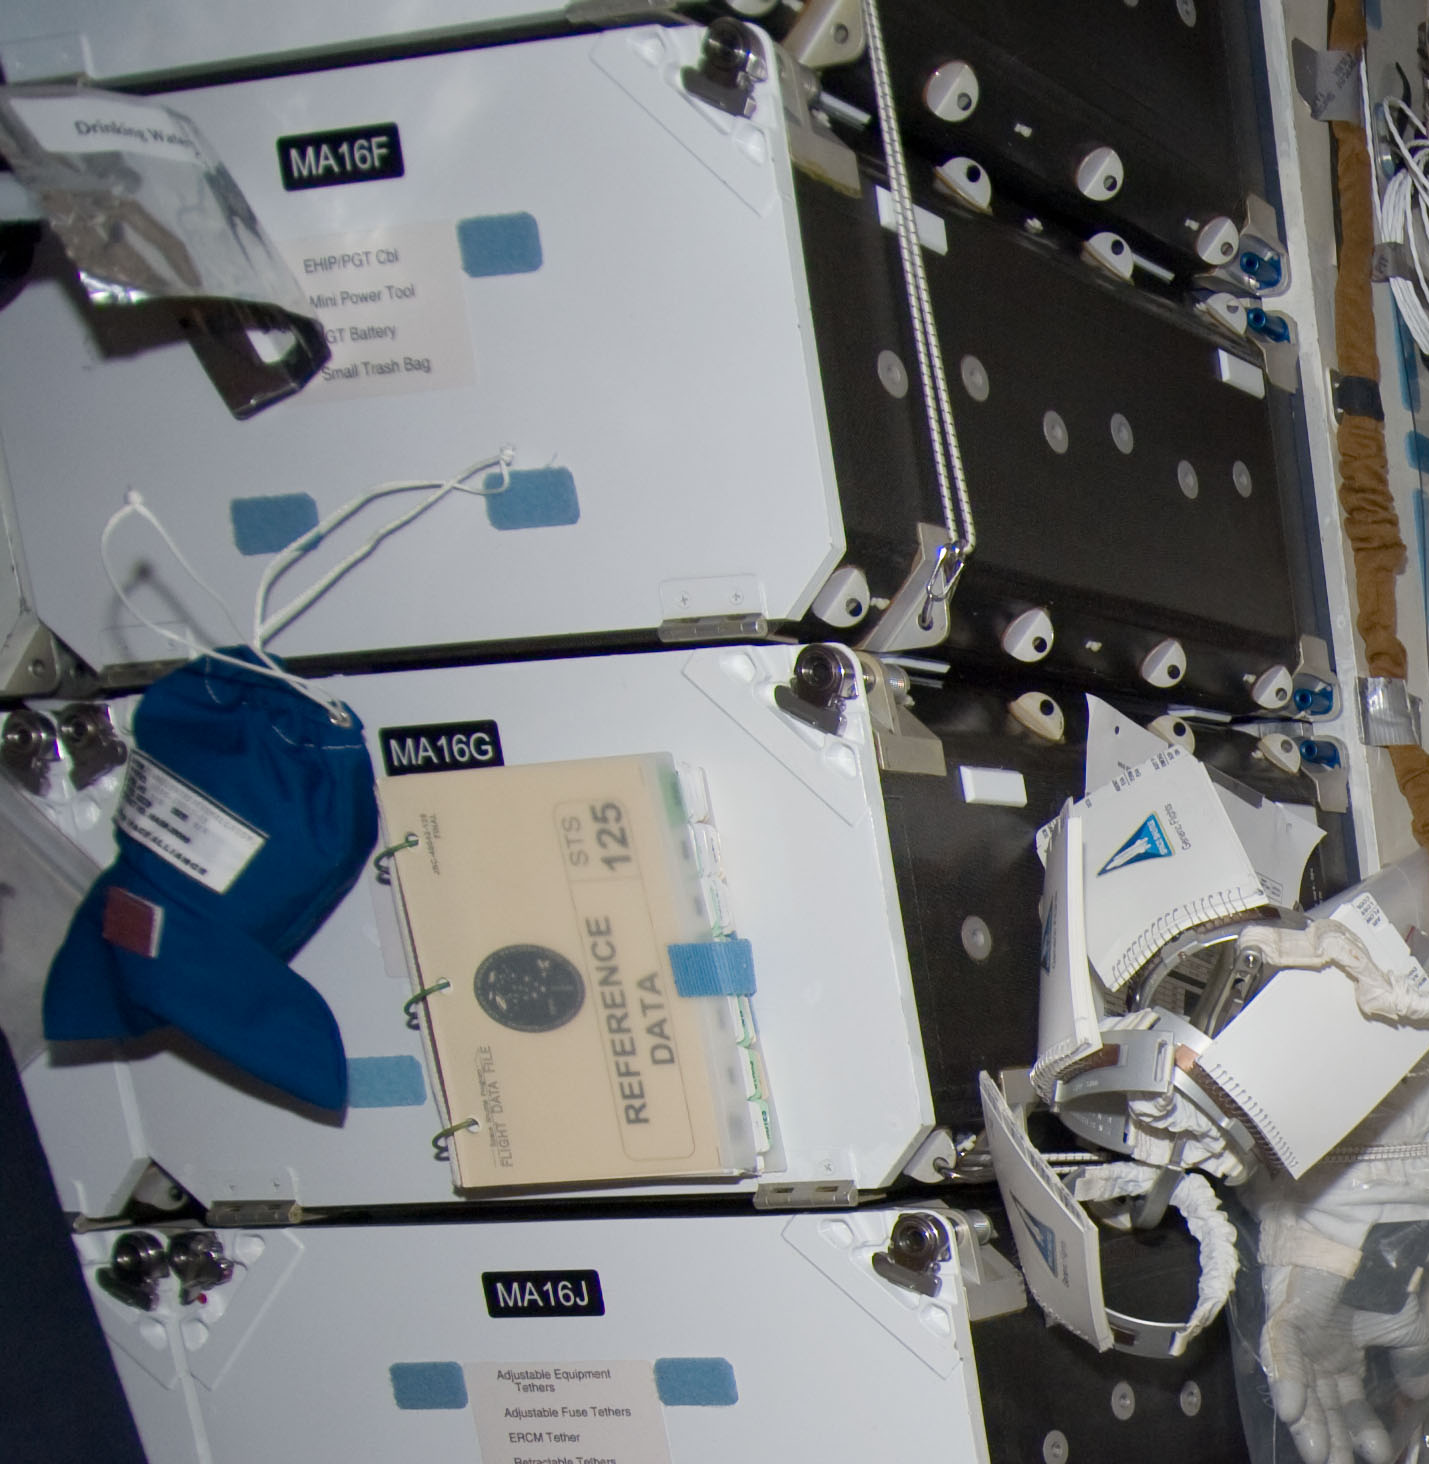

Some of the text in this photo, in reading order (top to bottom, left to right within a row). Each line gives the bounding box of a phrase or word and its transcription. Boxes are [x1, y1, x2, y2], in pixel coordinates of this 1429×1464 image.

[74, 119, 146, 142] Drinking
[289, 135, 390, 179] MA16F
[303, 251, 371, 274] EHIP/PGT
[310, 283, 416, 310] Mini Power Tool
[349, 324, 397, 343] Battery
[321, 356, 431, 381] Small Trash Bag
[389, 731, 494, 767] MA16G
[560, 815, 590, 868] STS
[589, 800, 633, 873] 125
[584, 914, 650, 1127] REFERENCE
[637, 971, 676, 1067] DATA
[481, 1046, 493, 1074] FILE
[488, 1079, 503, 1113] DATA
[497, 1119, 514, 1167] FLIGHT
[496, 1280, 589, 1308] MA16J
[497, 1368, 611, 1384] Adjustable Equipment
[515, 1382, 556, 1393] Tethers
[504, 1406, 632, 1421] Adjustable Fuse Tethers
[509, 1432, 580, 1444] ERCM Tether
